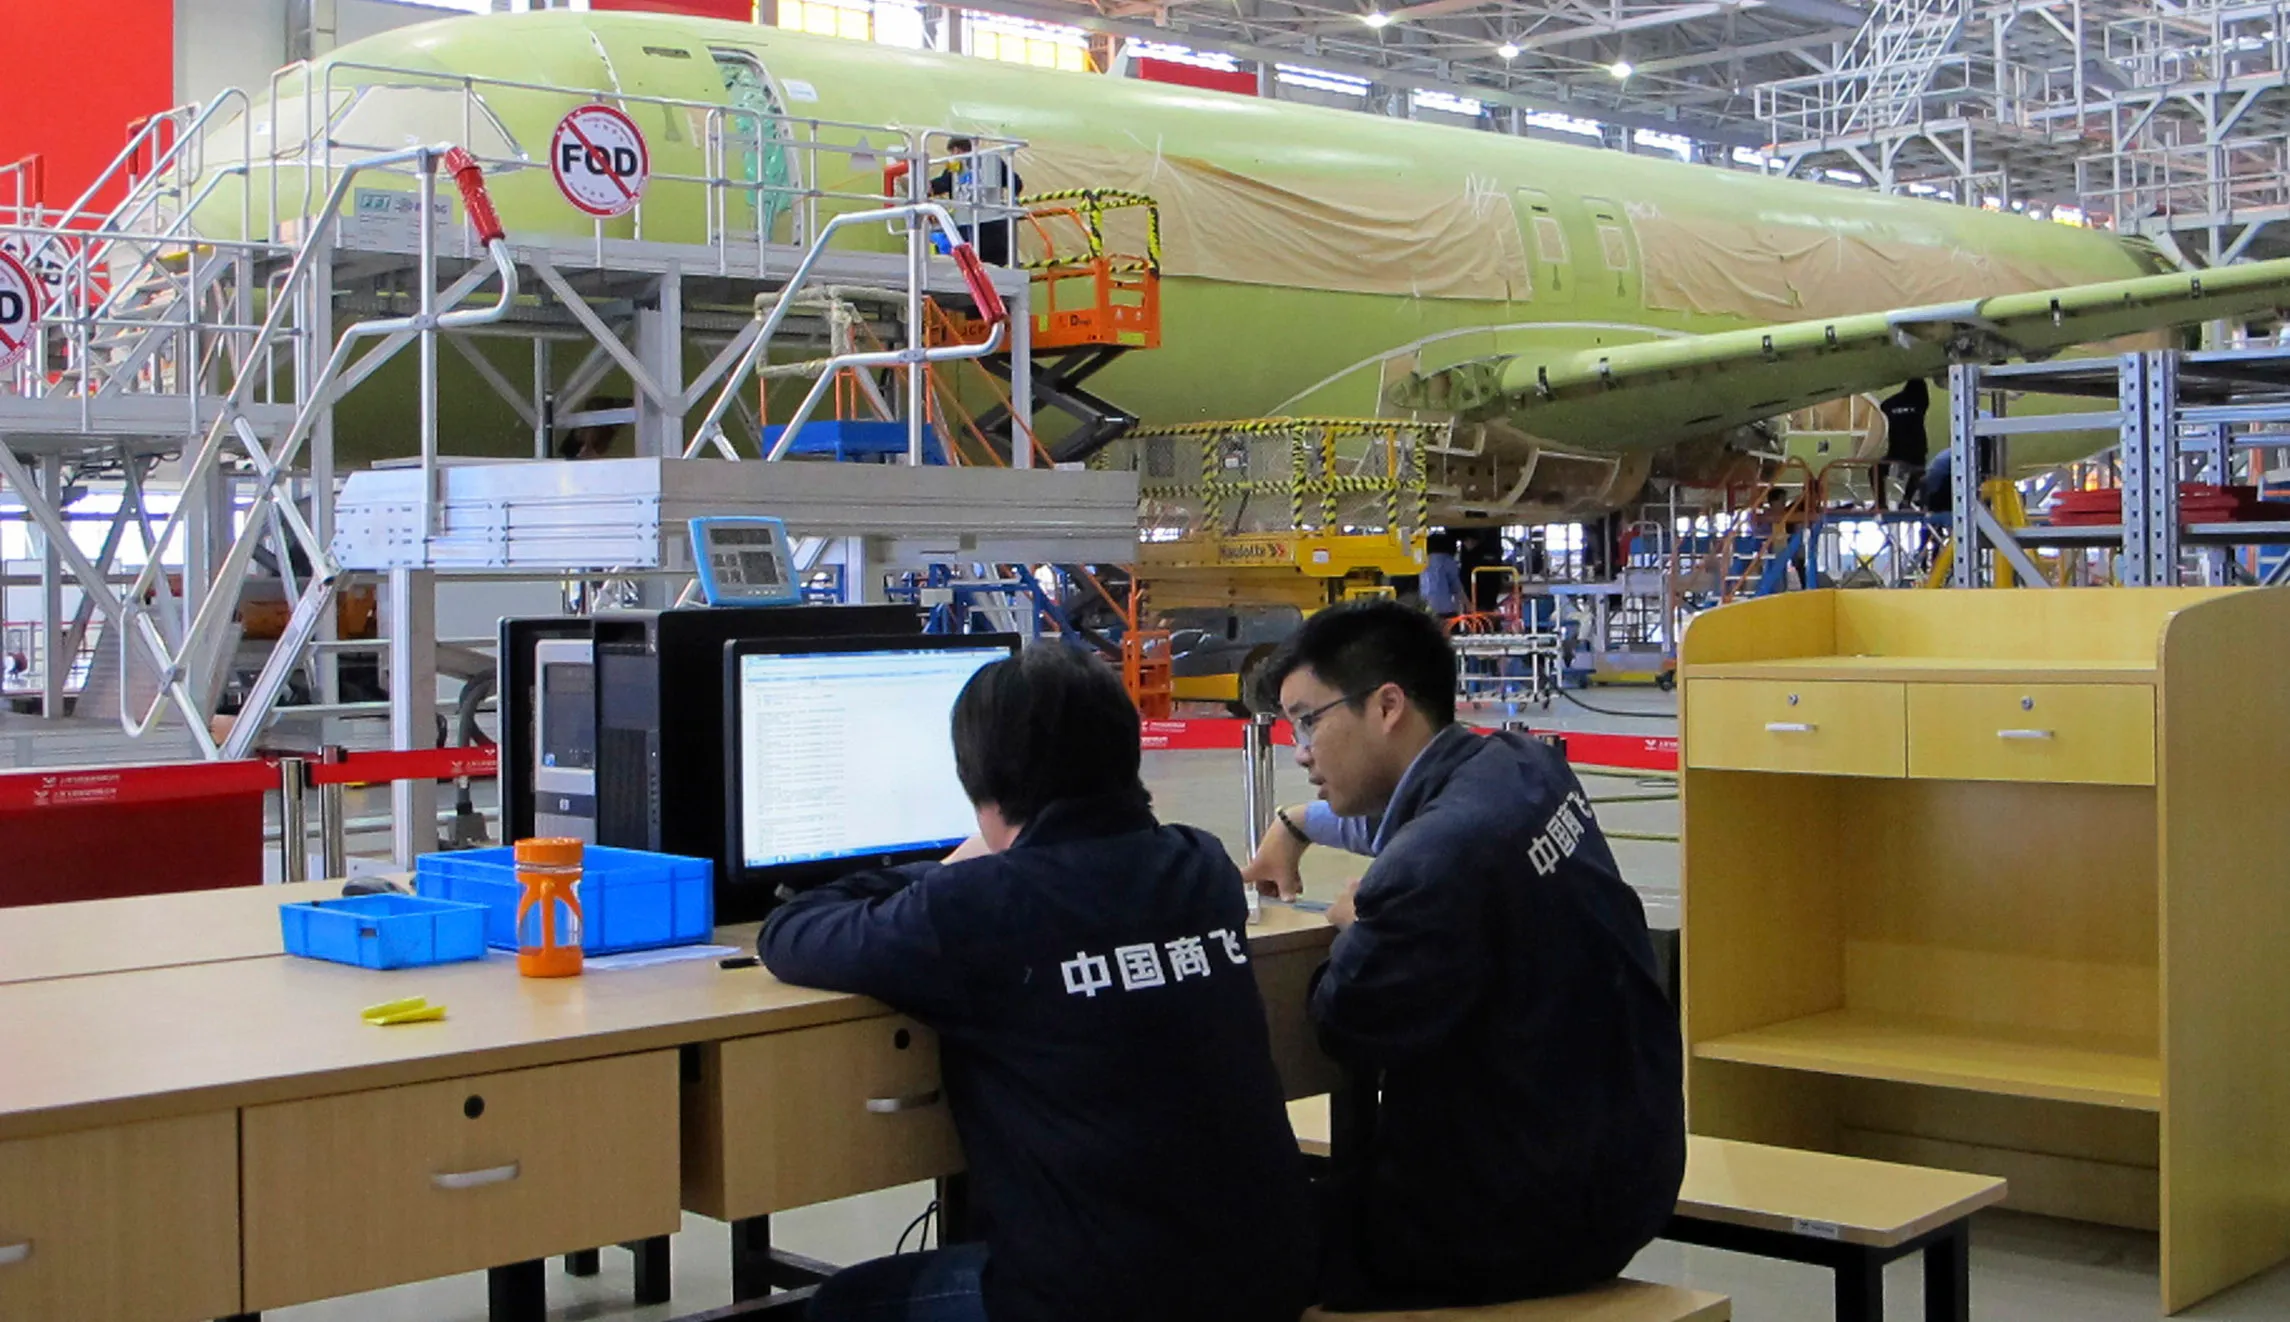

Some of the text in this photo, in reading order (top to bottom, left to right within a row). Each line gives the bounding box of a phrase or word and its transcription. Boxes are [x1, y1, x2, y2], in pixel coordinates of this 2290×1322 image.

[562, 143, 638, 177] FOD
[1527, 791, 1593, 876] 中国商飞
[1061, 928, 1248, 997] 中国商飞
